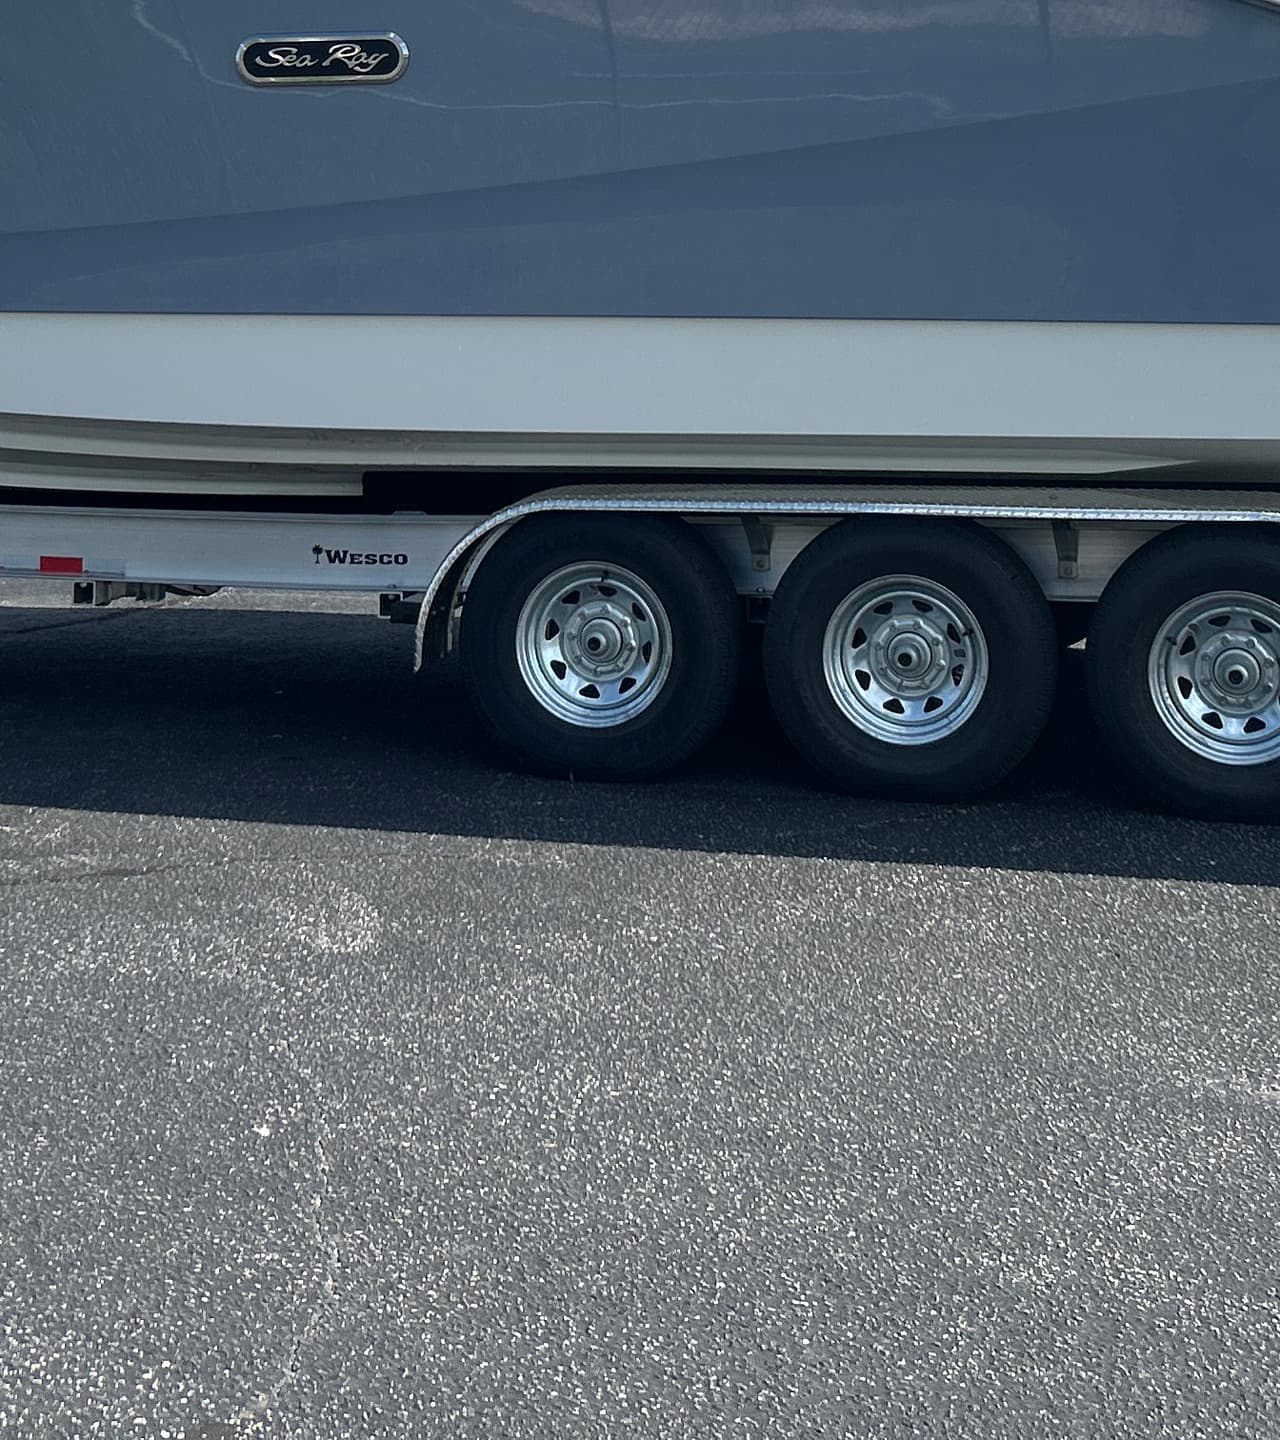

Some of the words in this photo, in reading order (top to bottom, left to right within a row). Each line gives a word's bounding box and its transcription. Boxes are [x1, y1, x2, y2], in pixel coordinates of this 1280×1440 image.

[255, 47, 320, 68] Sea
[322, 43, 389, 73] Ray
[325, 549, 409, 565] WESCO
